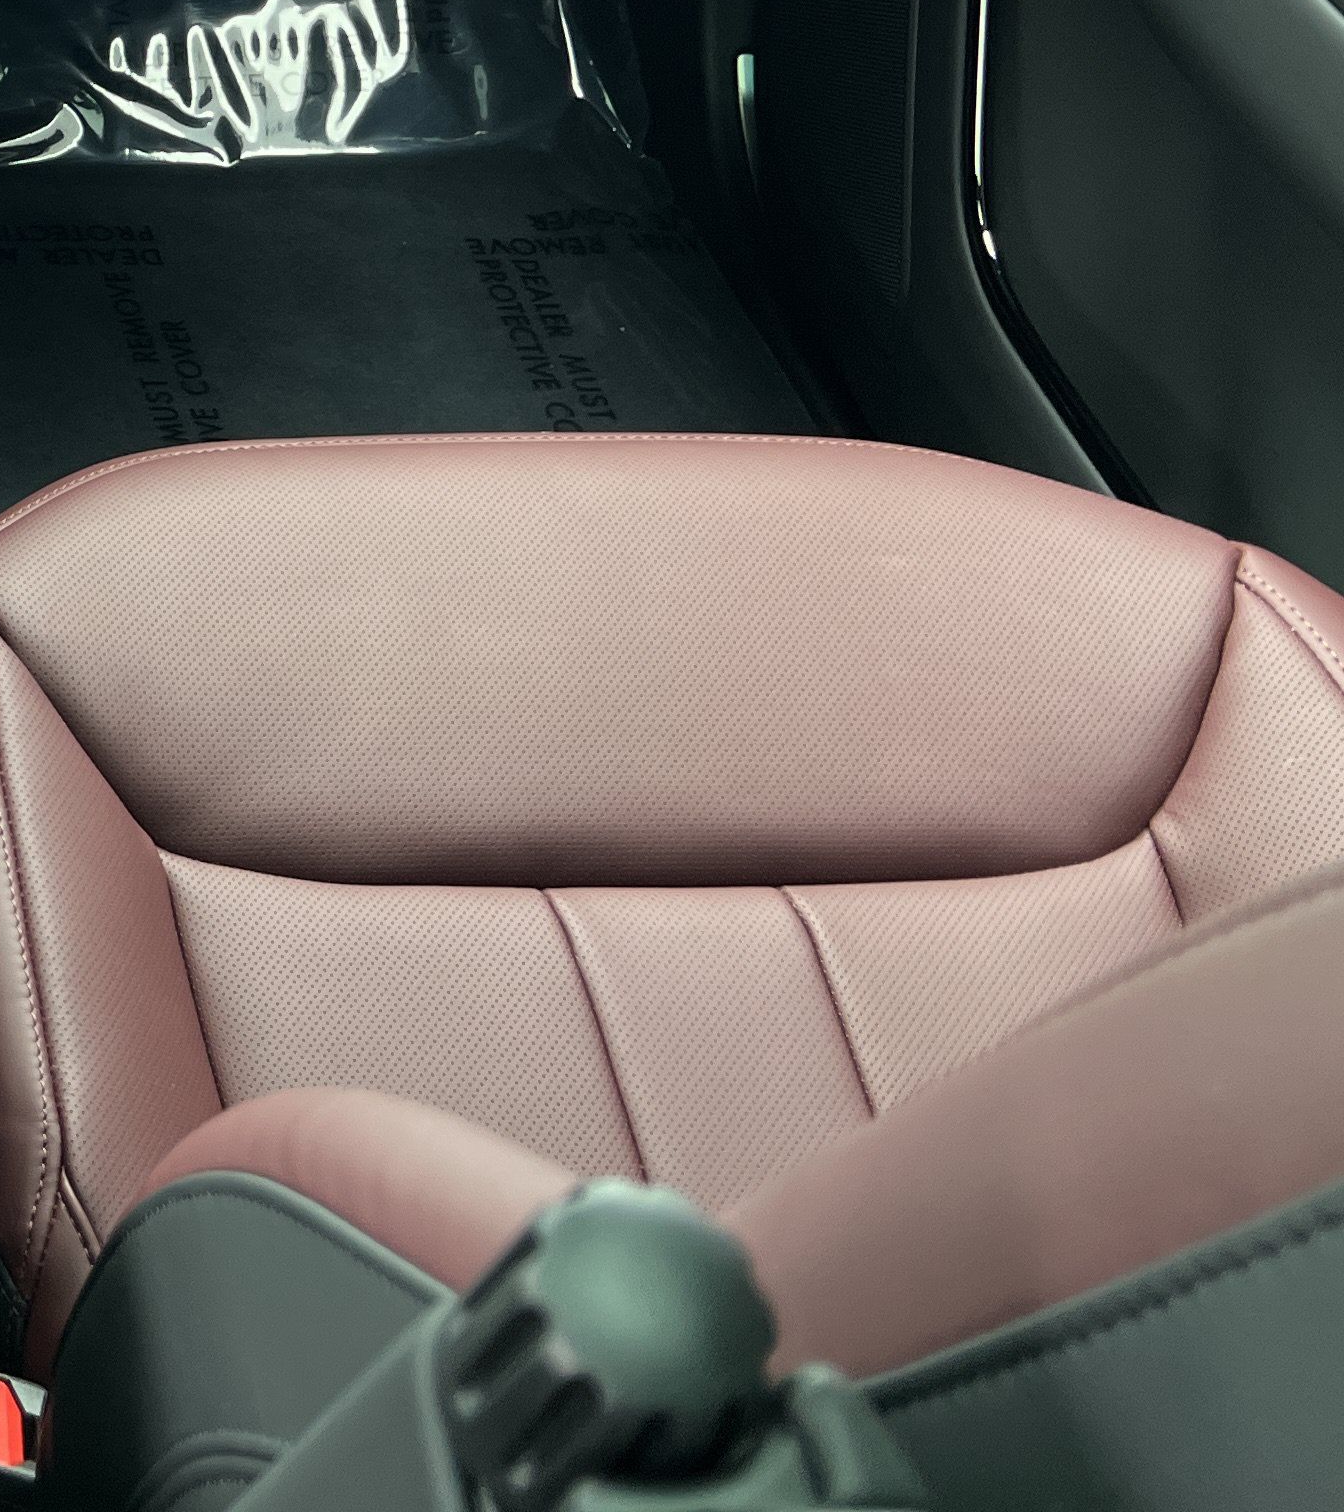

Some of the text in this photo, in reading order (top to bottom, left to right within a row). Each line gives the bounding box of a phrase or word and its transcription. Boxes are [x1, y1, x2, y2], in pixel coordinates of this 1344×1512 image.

[102, 272, 160, 363] REMOVE
[159, 319, 210, 395] COVER
[474, 257, 564, 391] PROTECTIVE
[511, 257, 575, 338] DEALER
[558, 353, 618, 422] MUST
